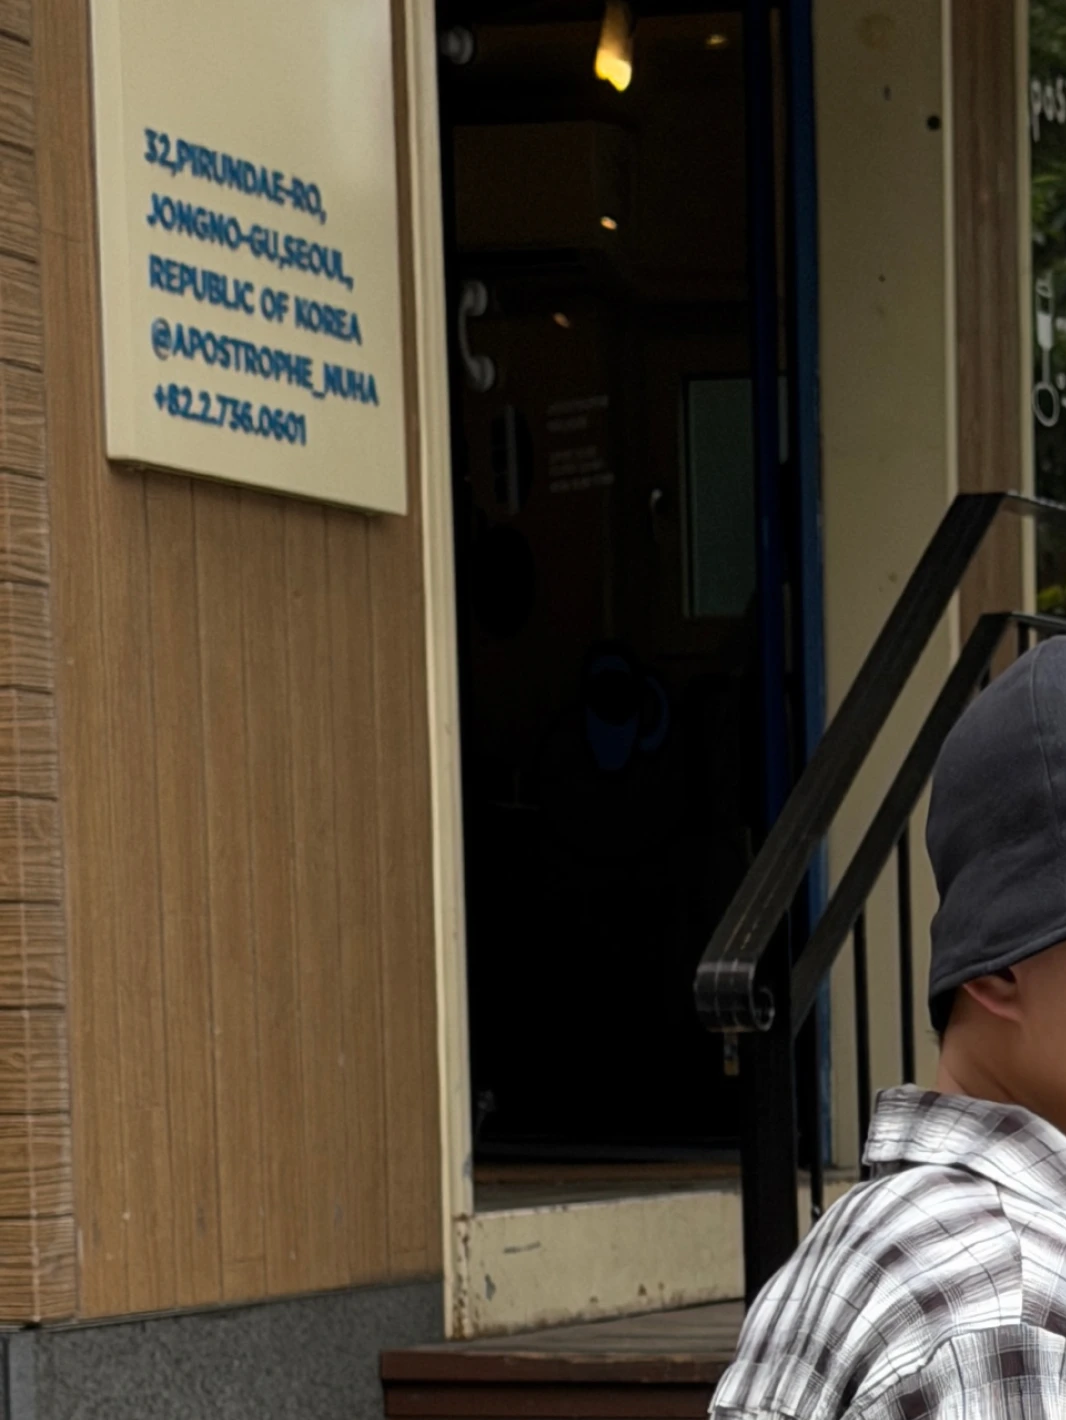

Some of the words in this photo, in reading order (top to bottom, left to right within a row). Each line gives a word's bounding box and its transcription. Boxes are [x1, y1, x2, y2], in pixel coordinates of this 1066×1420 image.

[149, 254, 254, 314] REPUBLIC
[261, 287, 289, 323] OF
[295, 297, 362, 346] KOREA
[152, 317, 379, 406] @APOSTROPHE_NUHA
